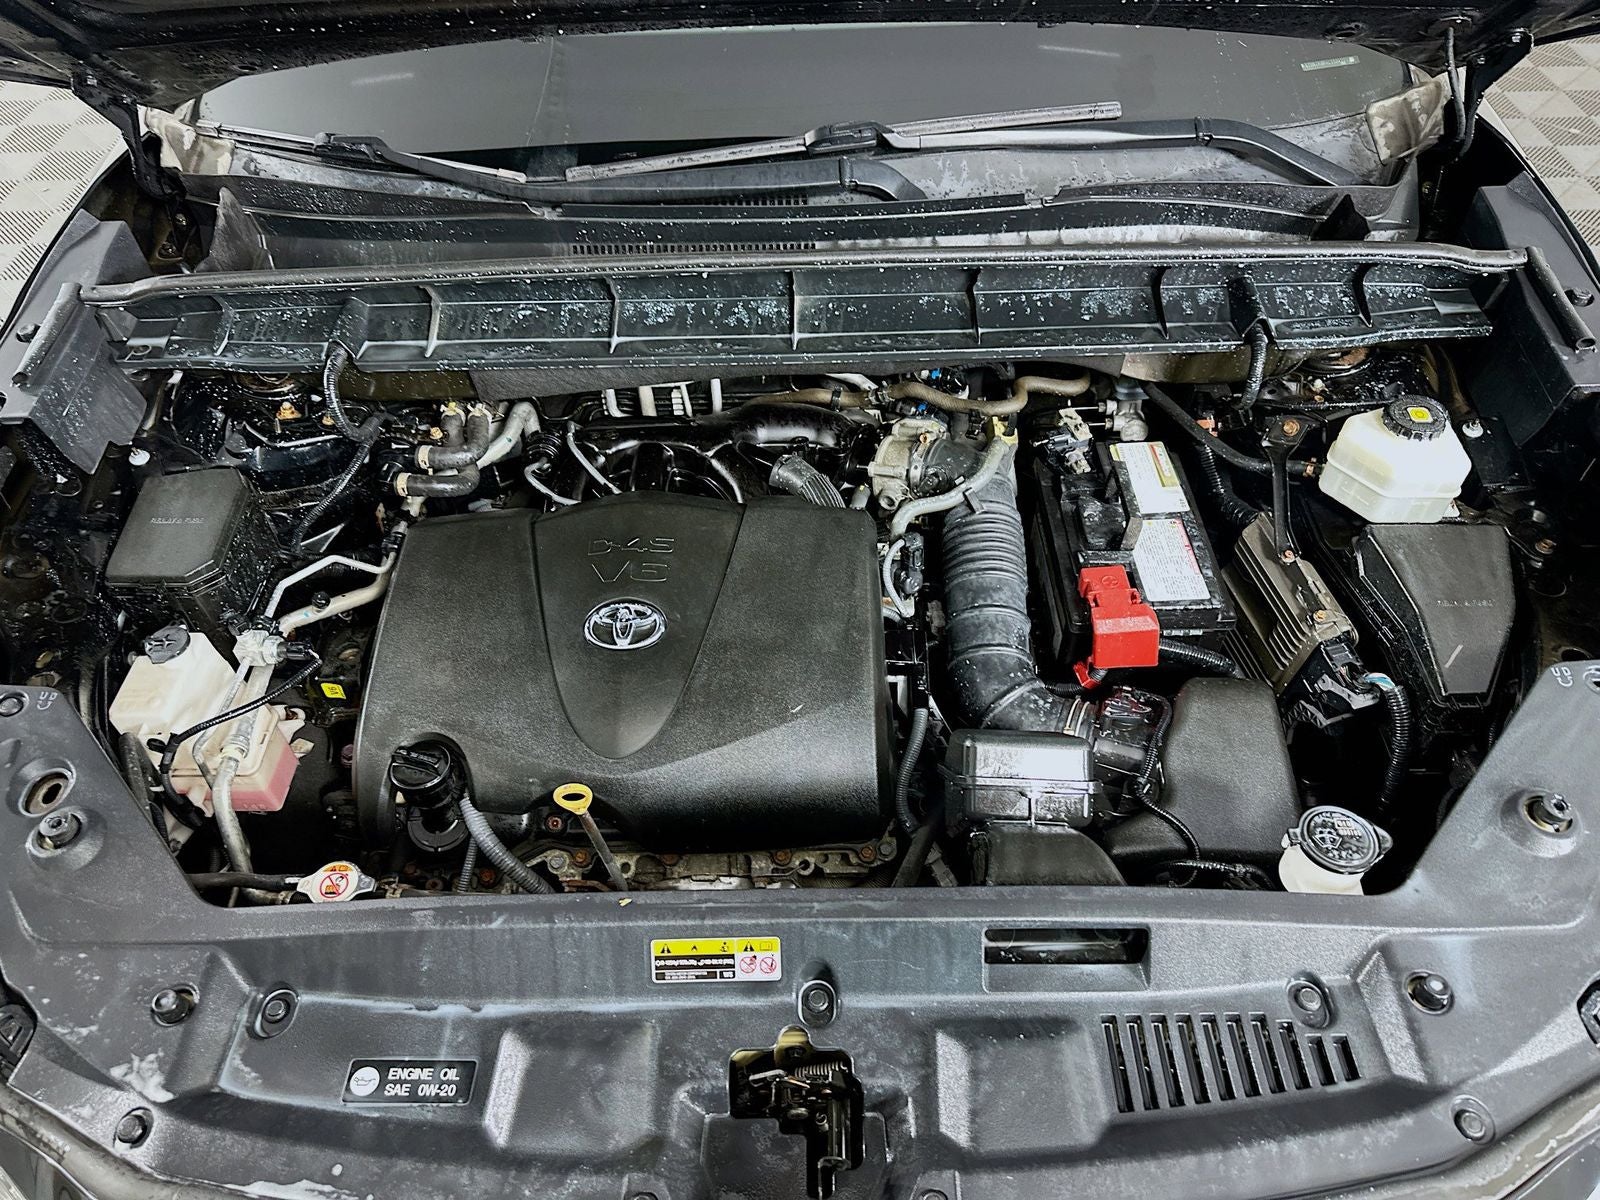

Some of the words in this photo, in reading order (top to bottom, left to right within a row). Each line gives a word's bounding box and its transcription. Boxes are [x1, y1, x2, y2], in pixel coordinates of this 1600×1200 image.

[591, 560, 671, 582] V6
[388, 1067, 434, 1081] ENGINE
[439, 1067, 460, 1081] OIL
[384, 1083, 411, 1097] SAE
[417, 1083, 457, 1097] 0W-20
